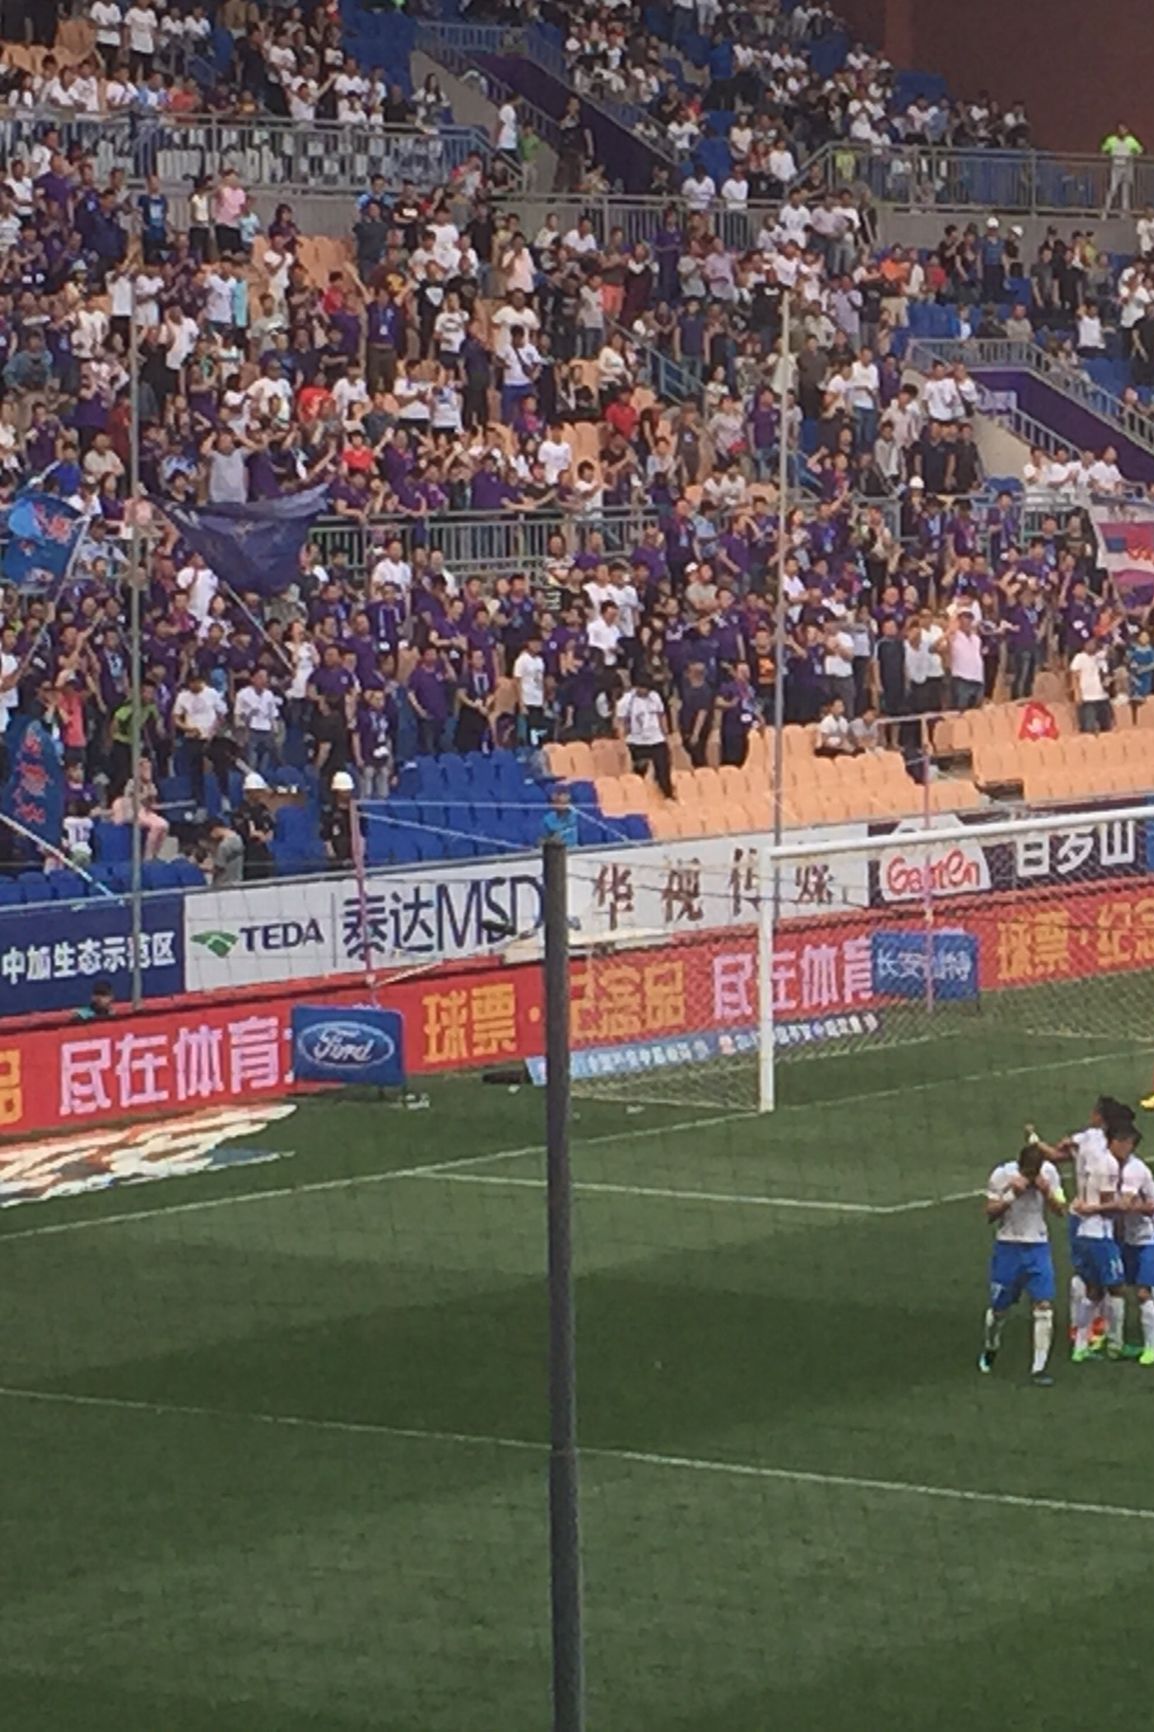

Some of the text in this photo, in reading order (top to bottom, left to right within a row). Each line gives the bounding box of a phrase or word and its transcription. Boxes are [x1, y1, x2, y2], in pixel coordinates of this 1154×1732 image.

[239, 917, 324, 953] TEDA
[2, 931, 176, 986] 中加生态示范区
[59, 1016, 293, 1116] 尽在体育
[311, 1026, 375, 1062] Ford
